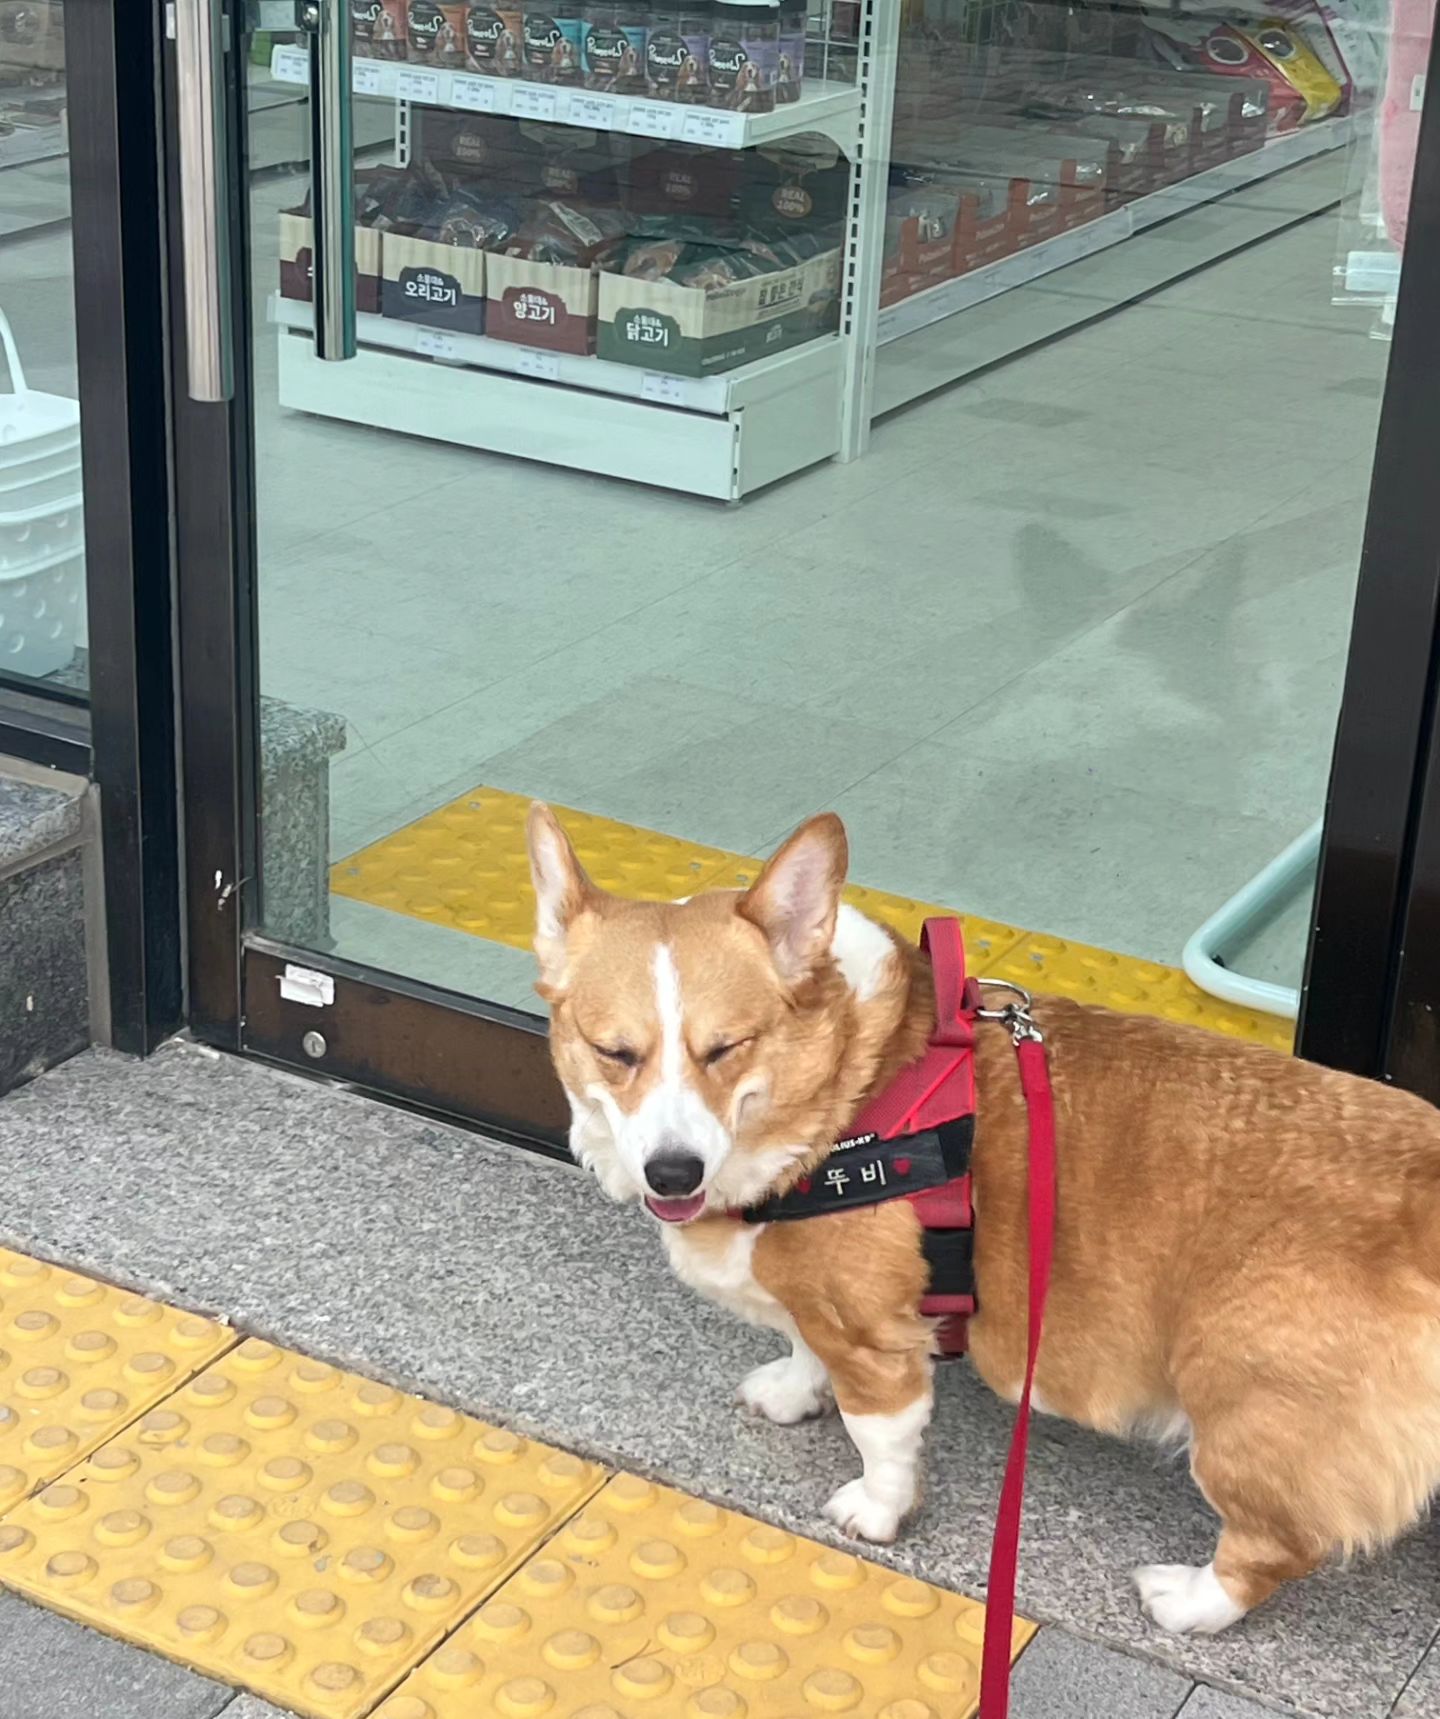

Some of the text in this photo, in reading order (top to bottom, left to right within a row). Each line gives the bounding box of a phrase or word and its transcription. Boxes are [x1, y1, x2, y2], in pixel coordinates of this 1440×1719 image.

[776, 197, 805, 214] 100%
[780, 188, 806, 202] REAL
[404, 281, 456, 306] 오리고기
[513, 301, 555, 325] 양고기
[626, 322, 668, 347] 닭고기
